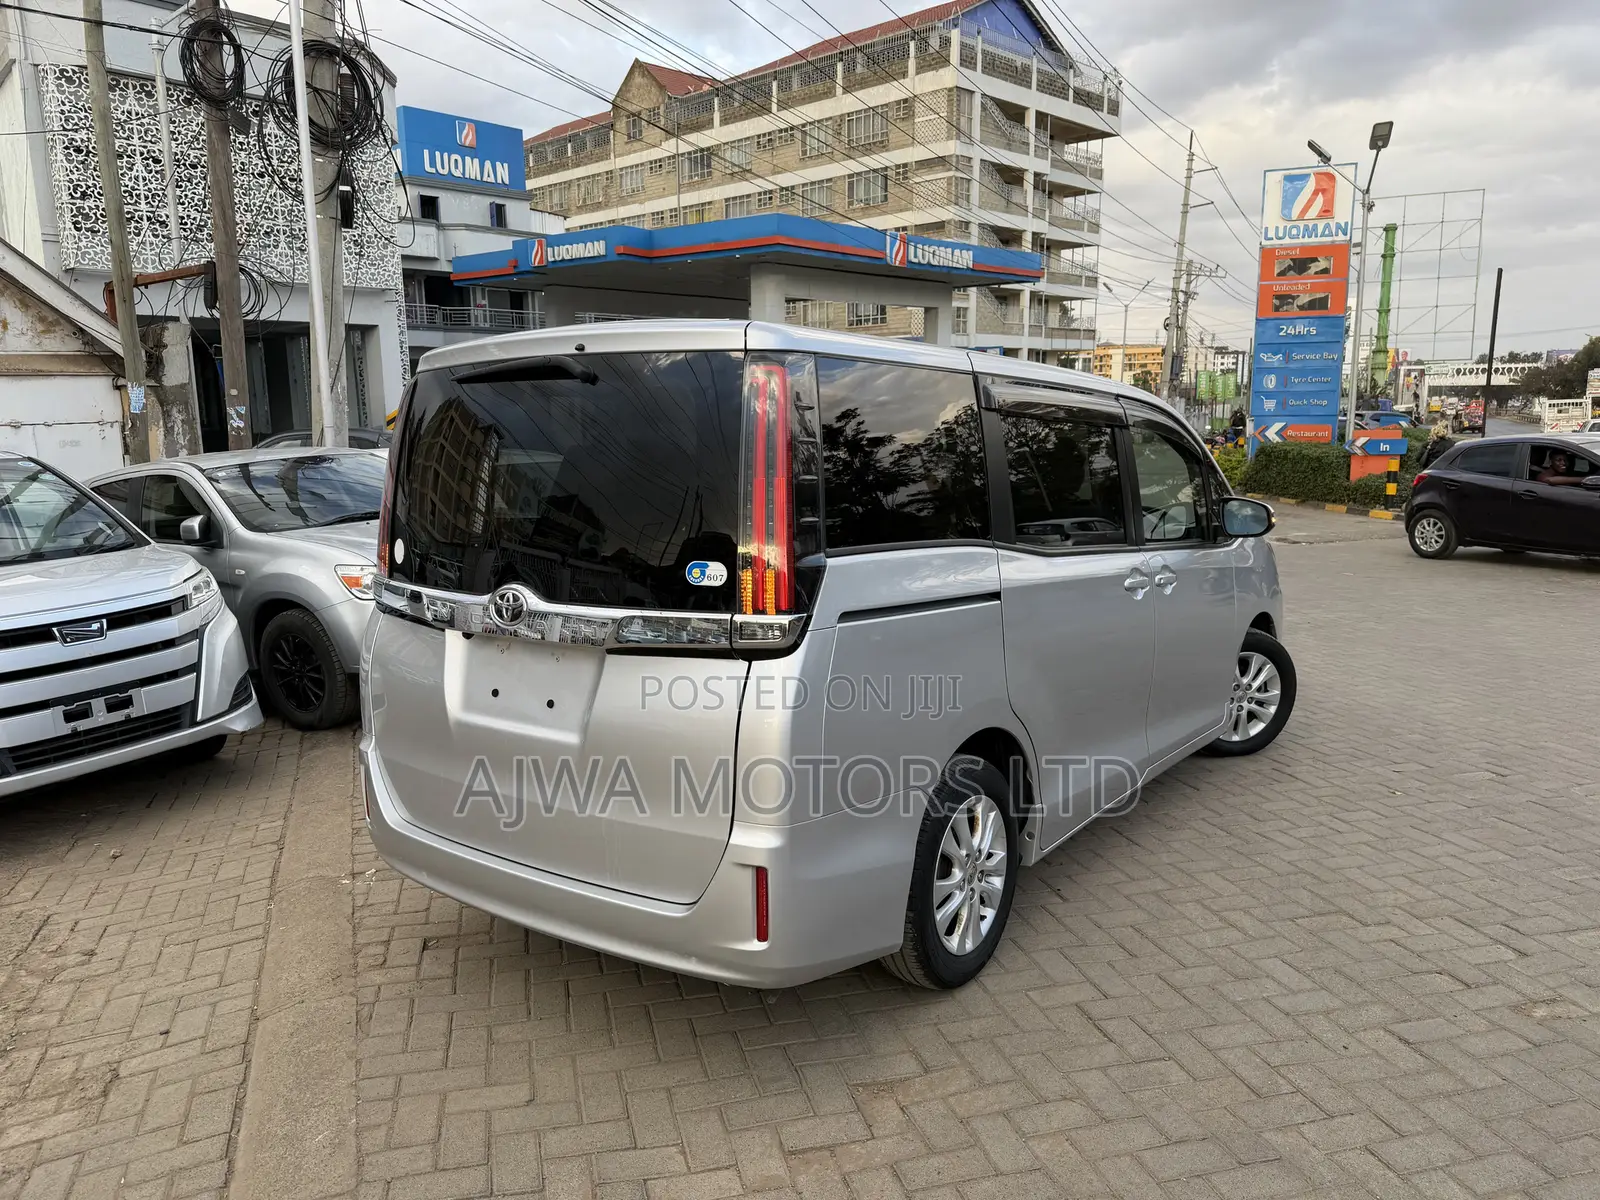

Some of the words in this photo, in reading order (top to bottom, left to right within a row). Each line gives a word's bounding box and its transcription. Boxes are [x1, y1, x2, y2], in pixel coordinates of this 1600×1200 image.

[423, 148, 509, 185] LUQMAN
[1263, 221, 1349, 240] LUQMAN
[547, 240, 606, 262] LUQMAN
[908, 242, 973, 269] LUQMAN
[1275, 248, 1300, 256] Diesel
[1272, 283, 1311, 291] Unleaded
[1278, 324, 1317, 336] 24Hrs
[1323, 352, 1338, 361] Bay
[1310, 398, 1328, 406] Shop
[1380, 442, 1390, 452] In
[706, 573, 724, 582] 607
